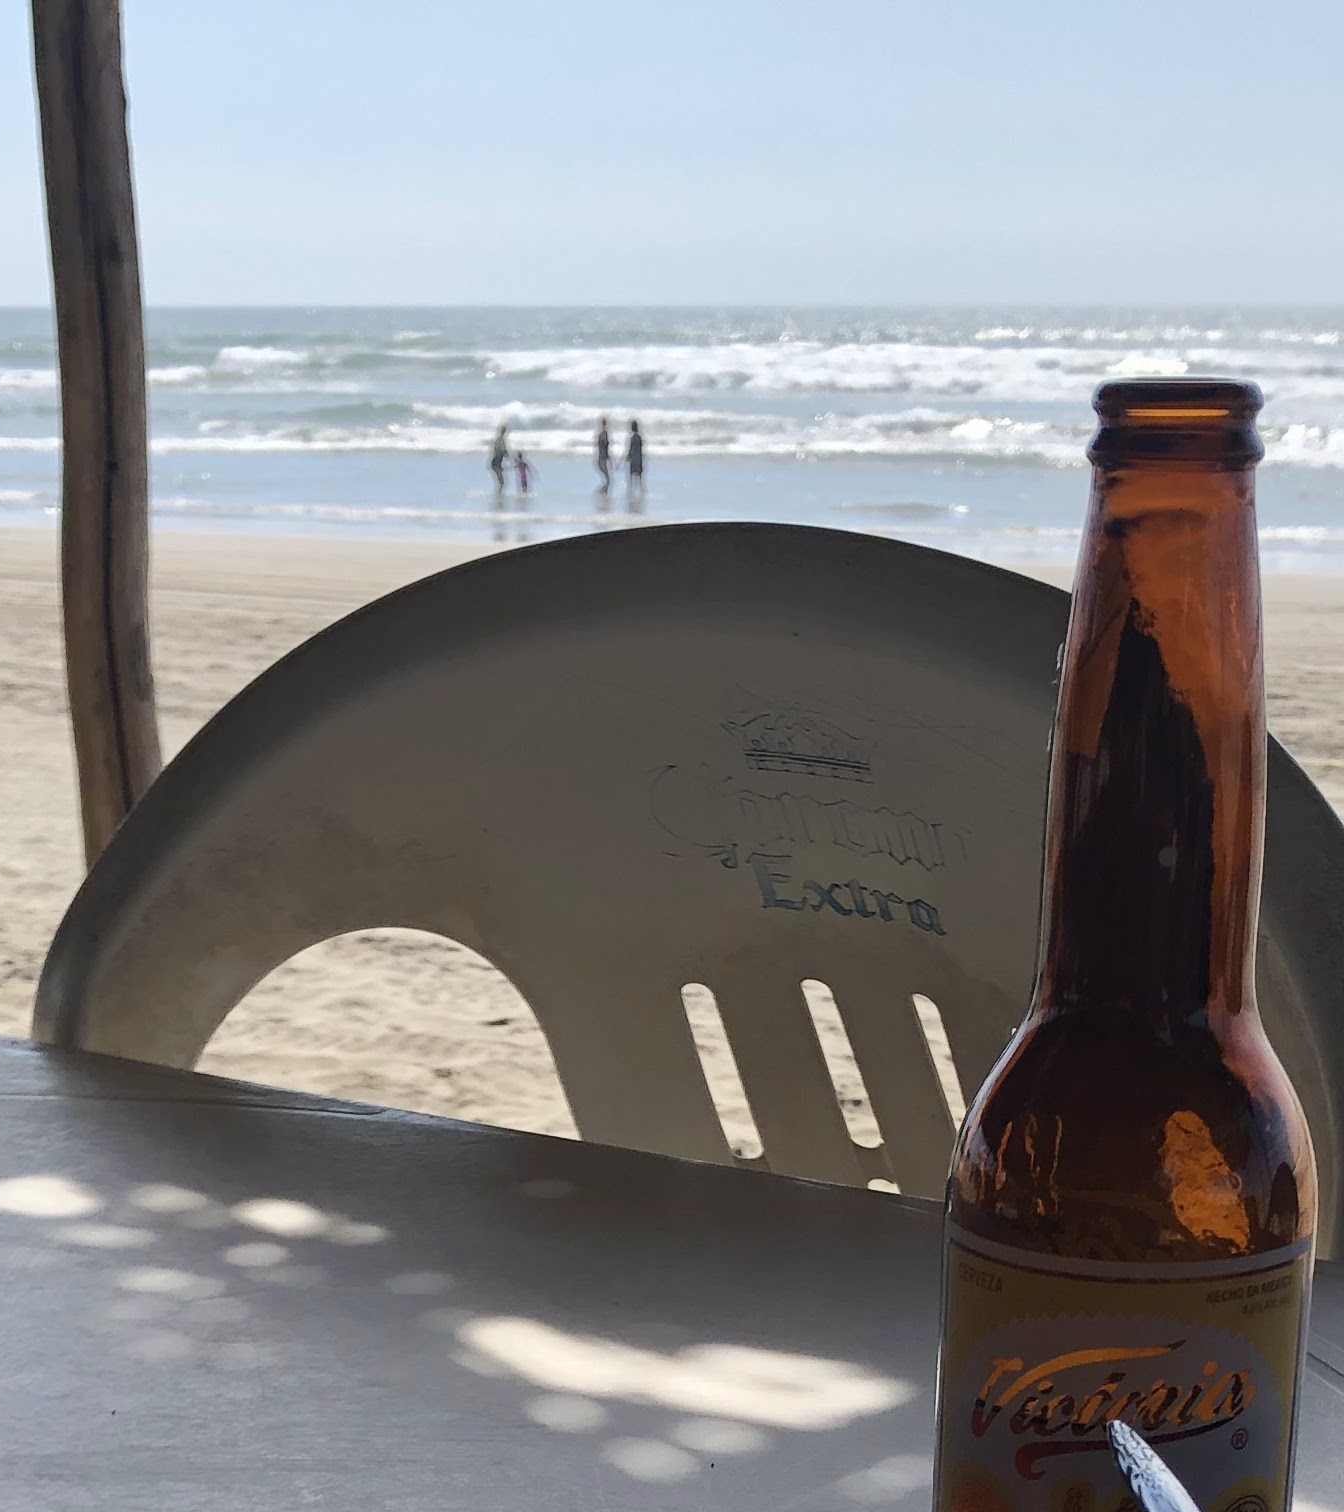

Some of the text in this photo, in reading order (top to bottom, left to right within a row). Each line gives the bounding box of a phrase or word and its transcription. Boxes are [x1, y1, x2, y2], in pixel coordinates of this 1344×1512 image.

[745, 851, 948, 936] Extra
[1205, 1287, 1244, 1305] HECHO
[970, 1338, 1257, 1481] Victoria
